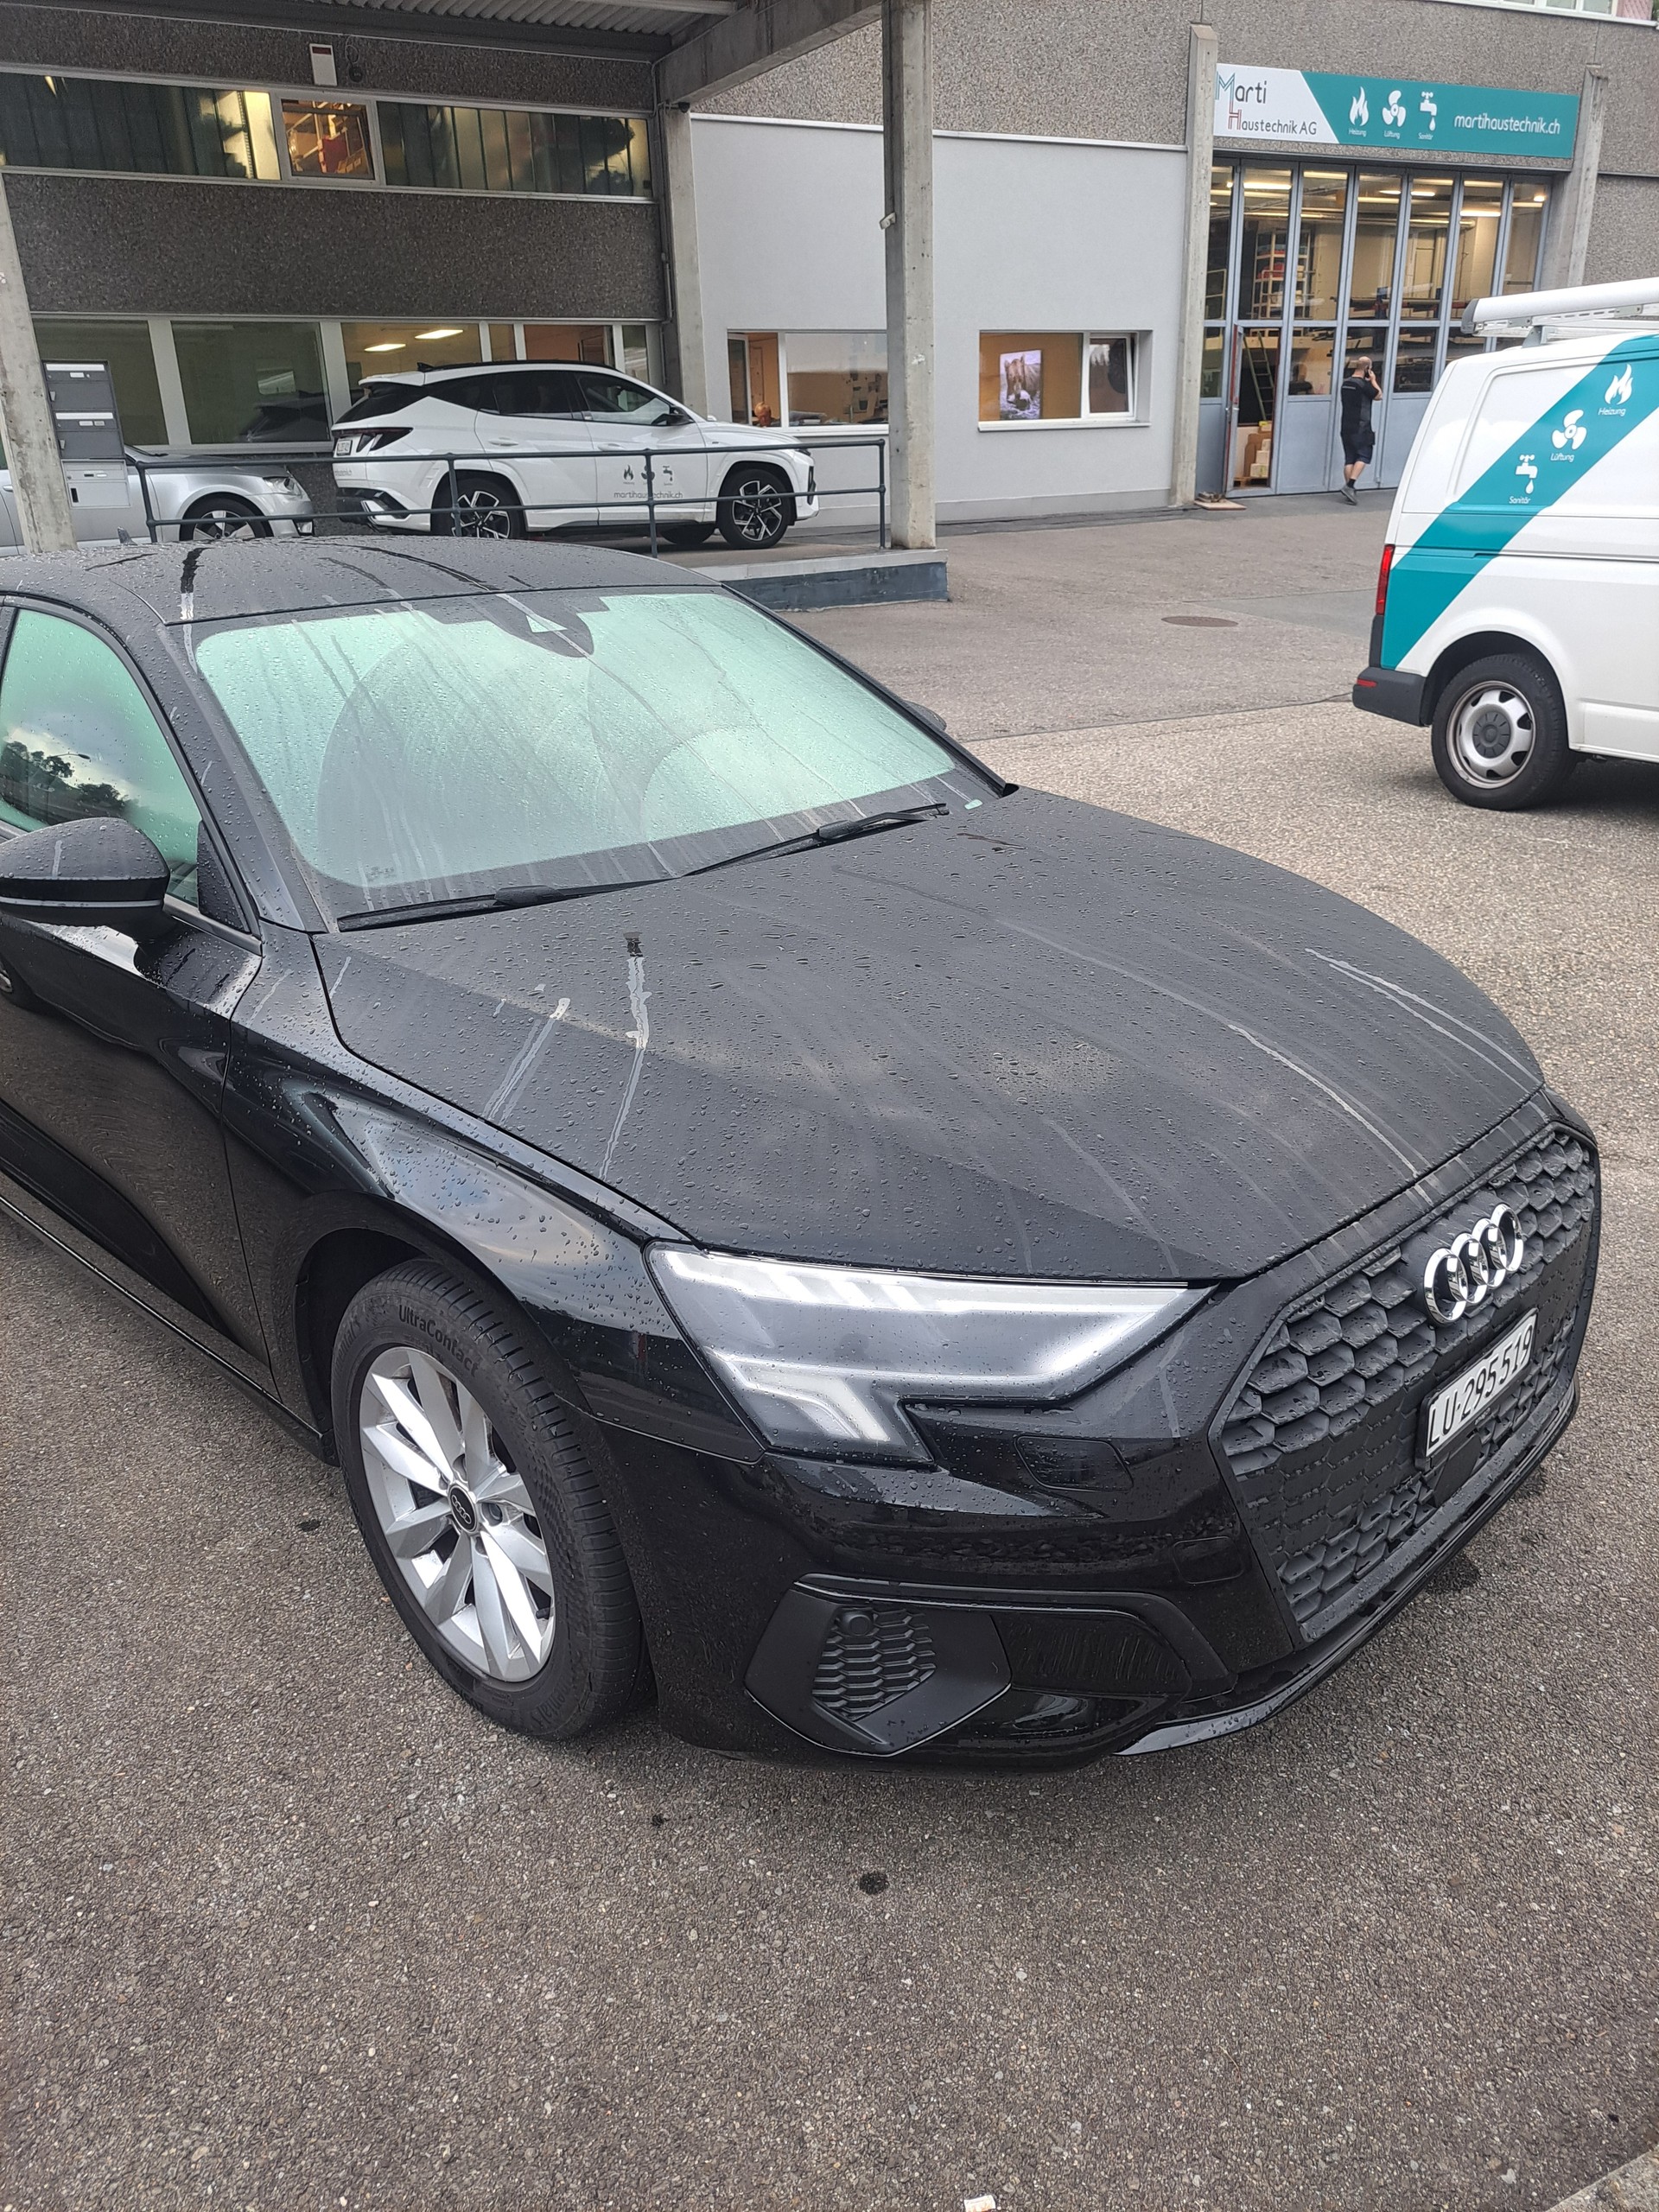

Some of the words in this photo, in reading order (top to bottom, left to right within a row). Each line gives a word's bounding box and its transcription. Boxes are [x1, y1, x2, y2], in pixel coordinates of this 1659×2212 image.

[1215, 71, 1268, 105] Marti
[1228, 109, 1298, 134] Haustechnik
[1299, 121, 1318, 135] AG
[1454, 113, 1560, 134] martihaustechnik.ch
[1598, 407, 1626, 417] Heizung
[1550, 453, 1575, 463] Lüftung
[1509, 496, 1531, 505] Sanitär
[398, 1304, 480, 1377] UltraContact
